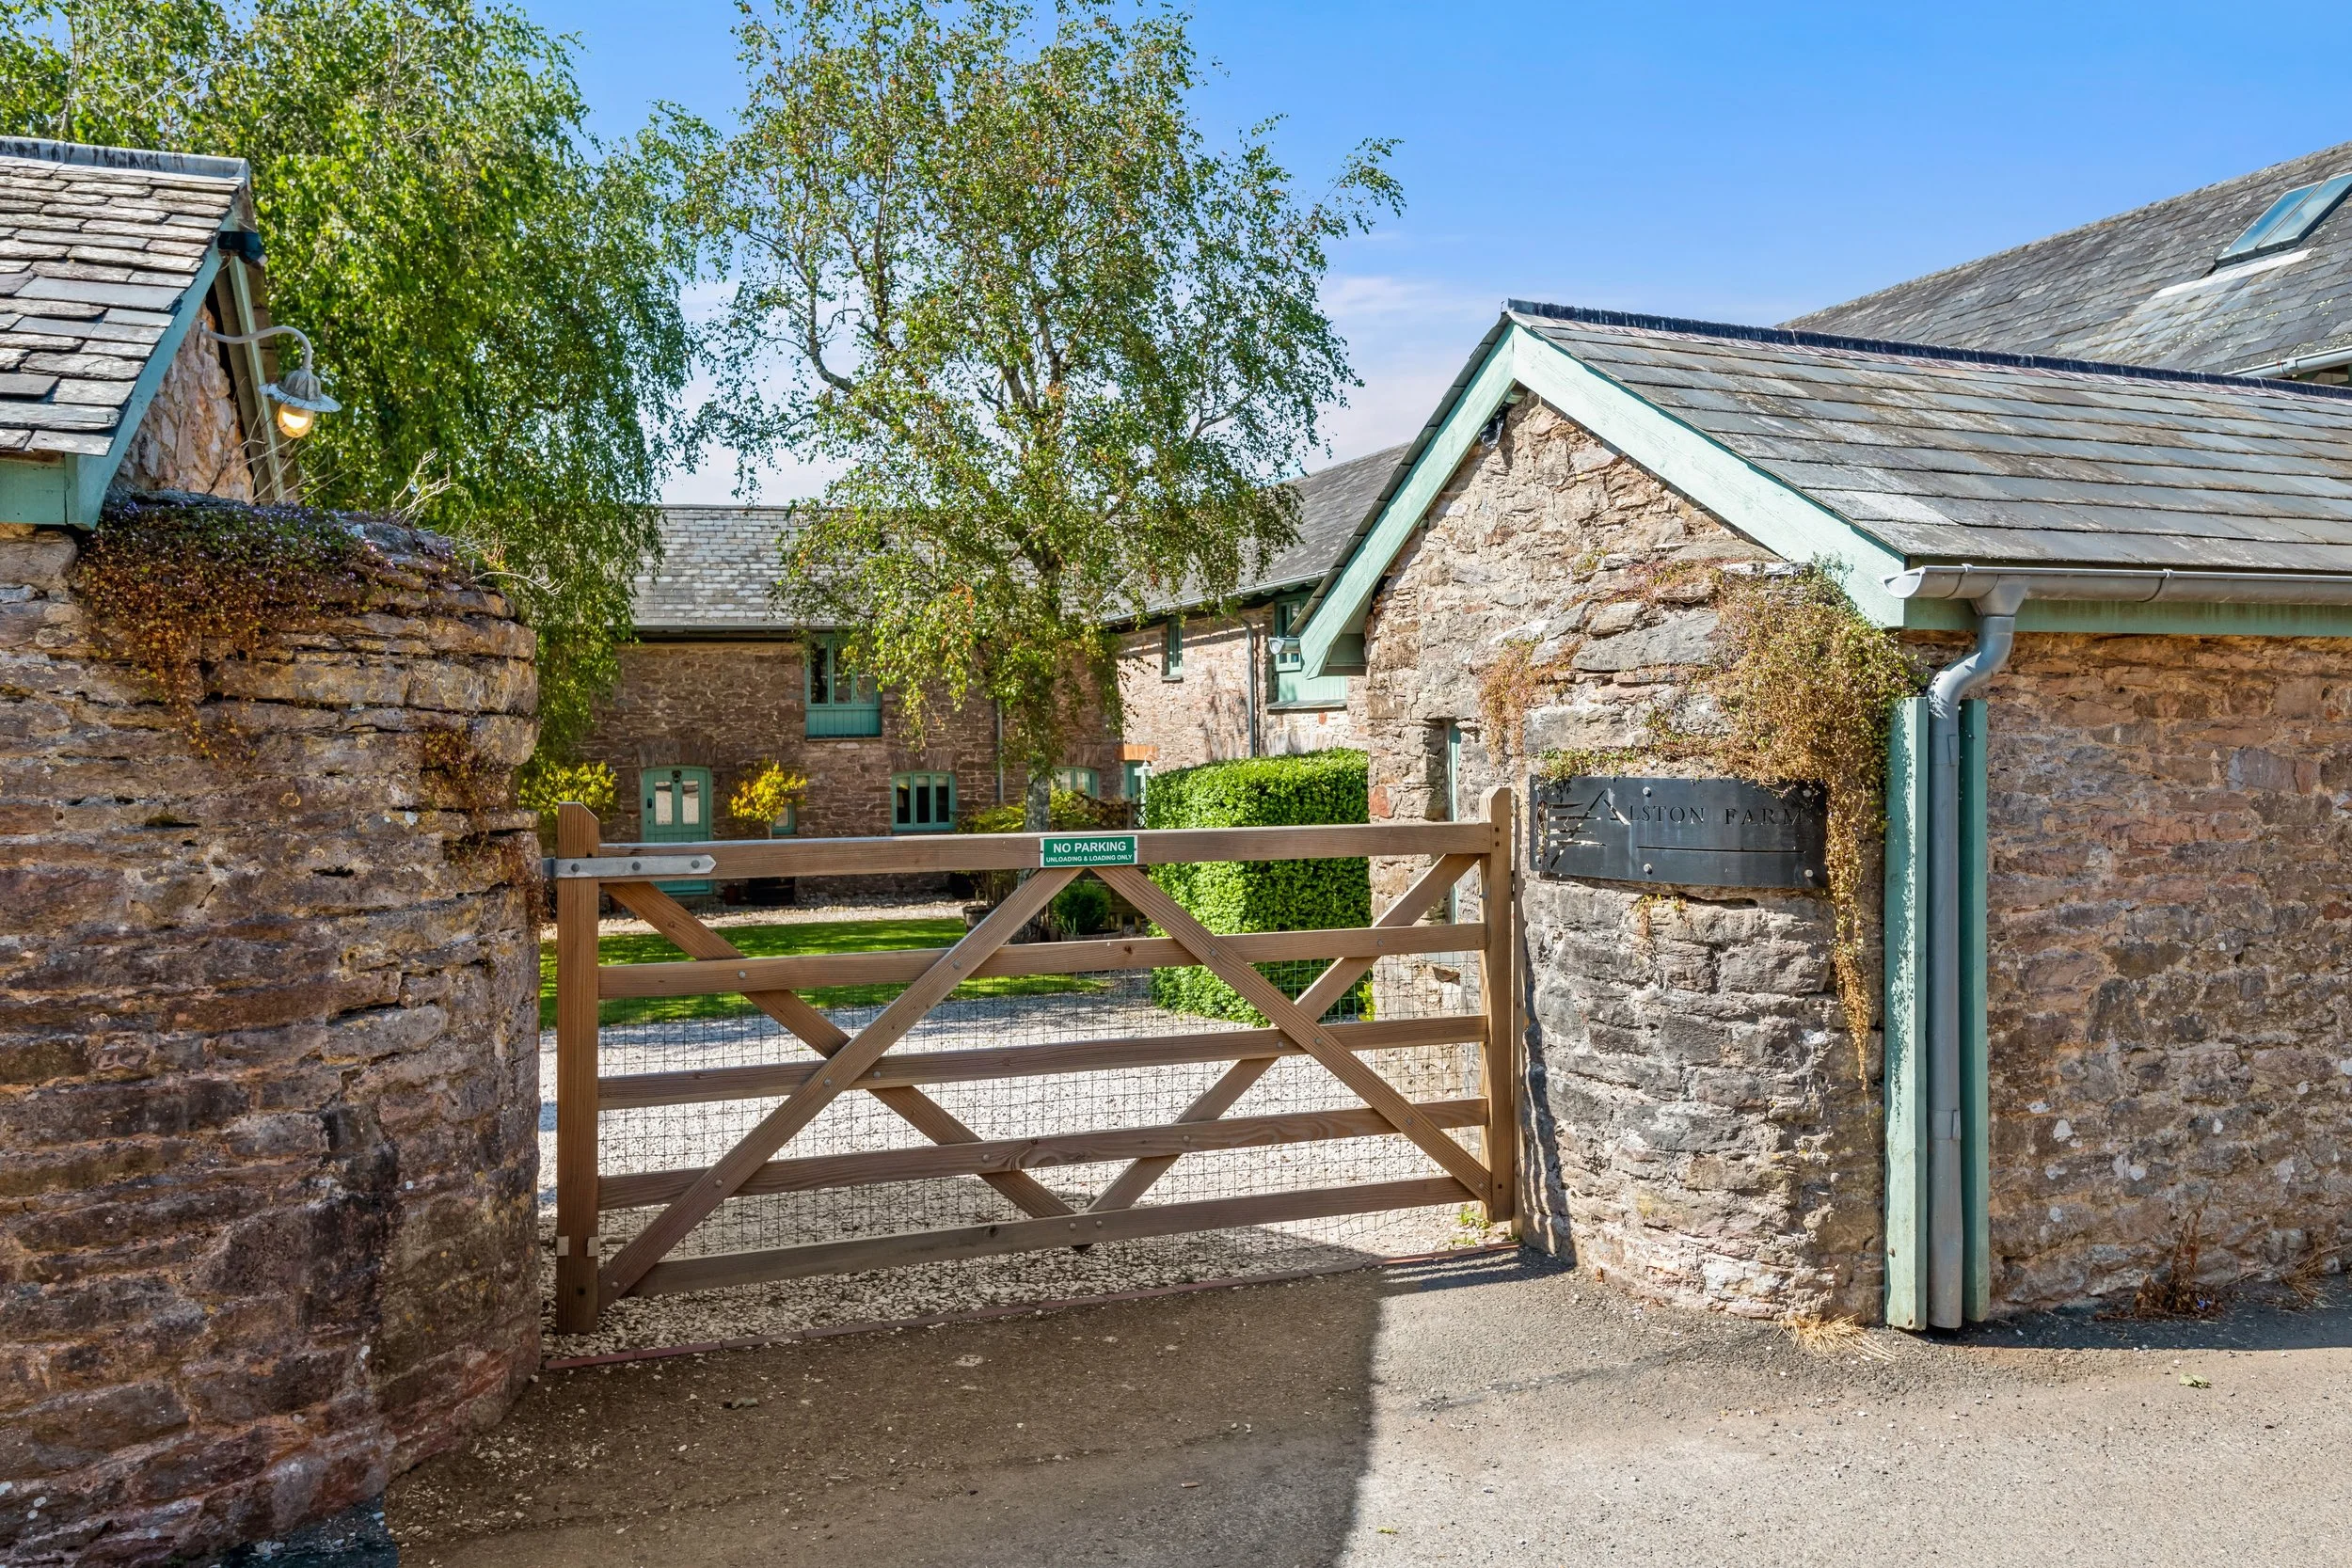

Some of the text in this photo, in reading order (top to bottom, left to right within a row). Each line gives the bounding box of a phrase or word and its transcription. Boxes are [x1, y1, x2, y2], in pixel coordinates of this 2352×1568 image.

[1724, 807, 1803, 825] FARM
[1053, 841, 1126, 853] NO PARKING
